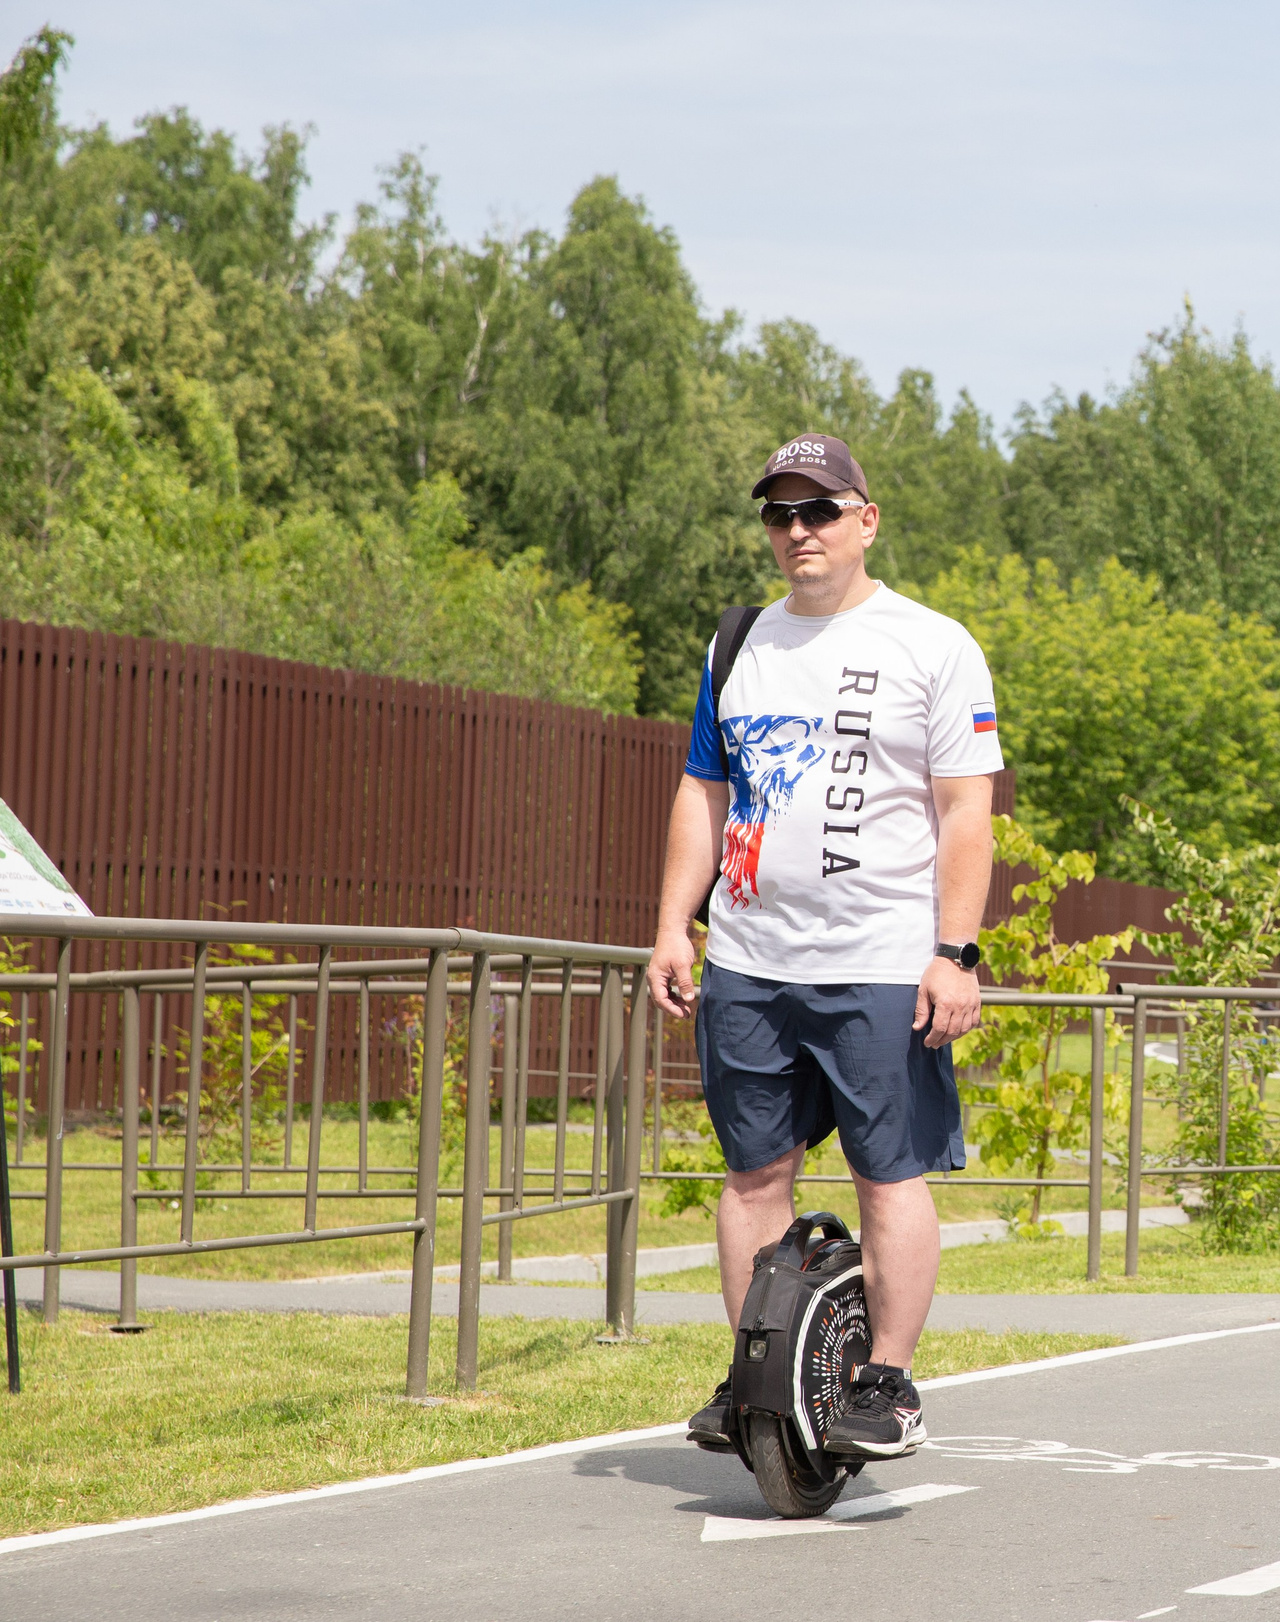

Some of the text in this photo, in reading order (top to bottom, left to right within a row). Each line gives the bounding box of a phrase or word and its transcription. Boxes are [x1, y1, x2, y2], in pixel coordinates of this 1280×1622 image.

[775, 441, 825, 463] BOSS
[772, 456, 827, 473] HUGO BOSS
[822, 666, 879, 878] RUSSIA
